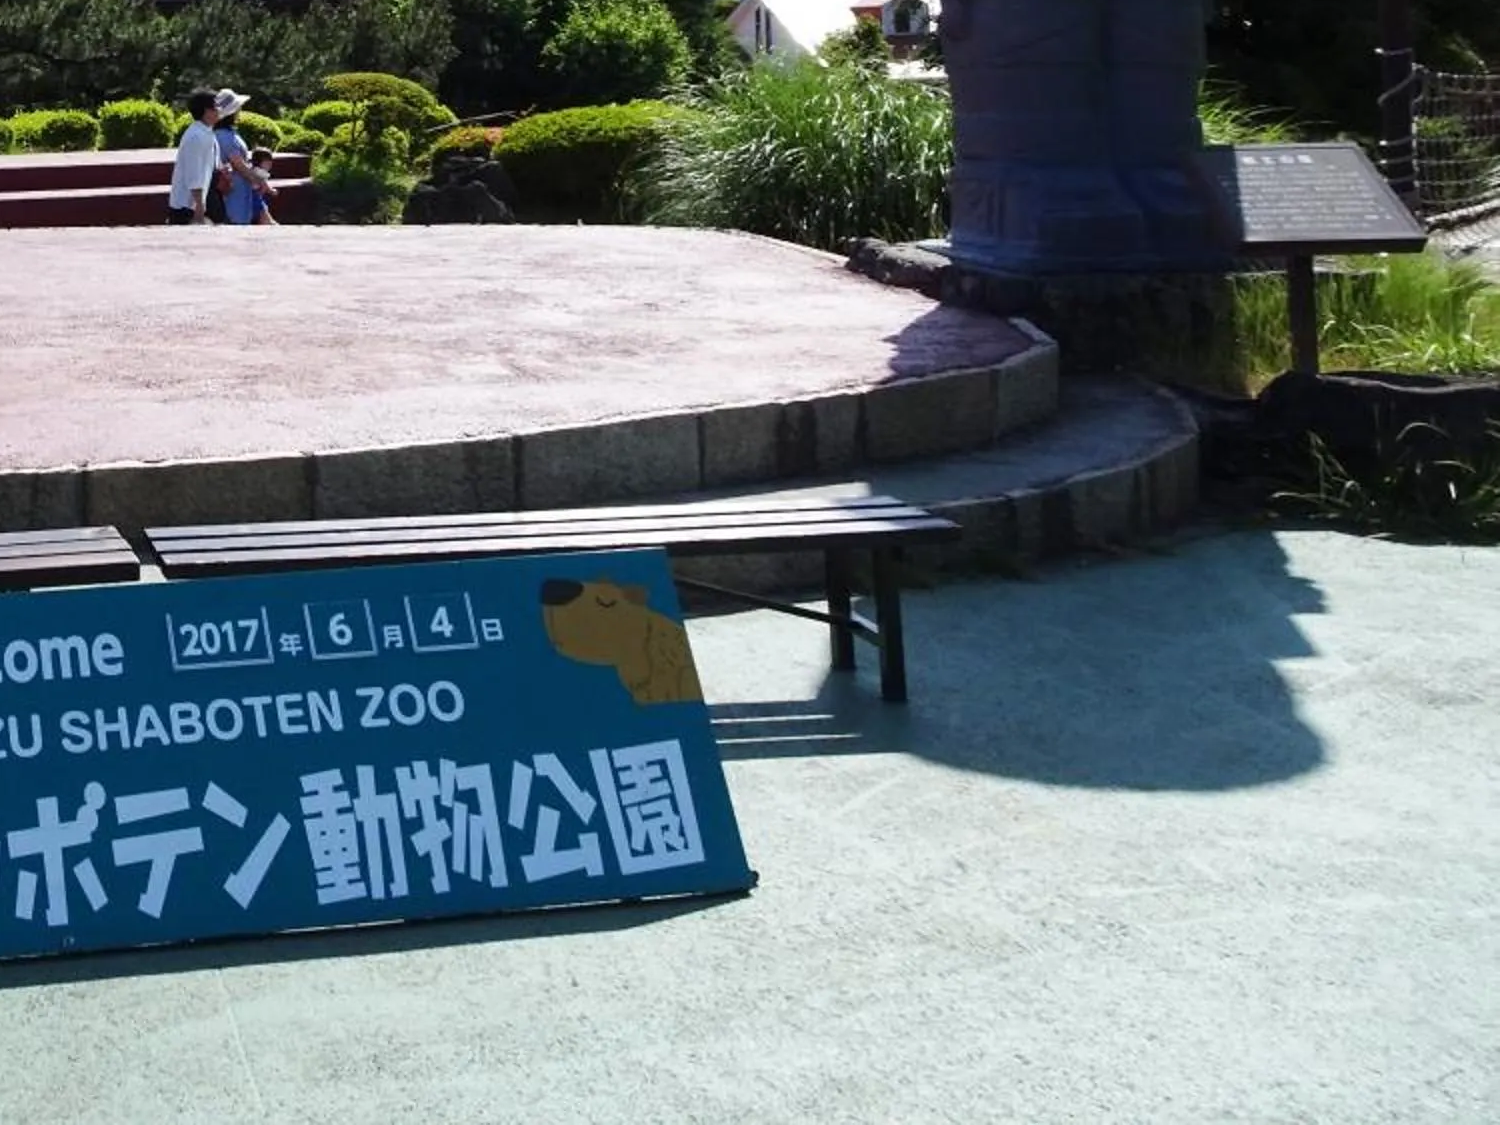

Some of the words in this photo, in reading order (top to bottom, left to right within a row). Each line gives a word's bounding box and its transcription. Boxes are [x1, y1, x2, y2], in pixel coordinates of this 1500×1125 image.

[180, 620, 258, 656] 2017
[279, 633, 303, 656] 年
[328, 613, 353, 646] 6
[382, 625, 404, 648] 月
[430, 606, 453, 638] 4
[481, 619, 504, 641] 日
[62, 691, 342, 752] SHABOTEN
[356, 682, 463, 727] ZOO
